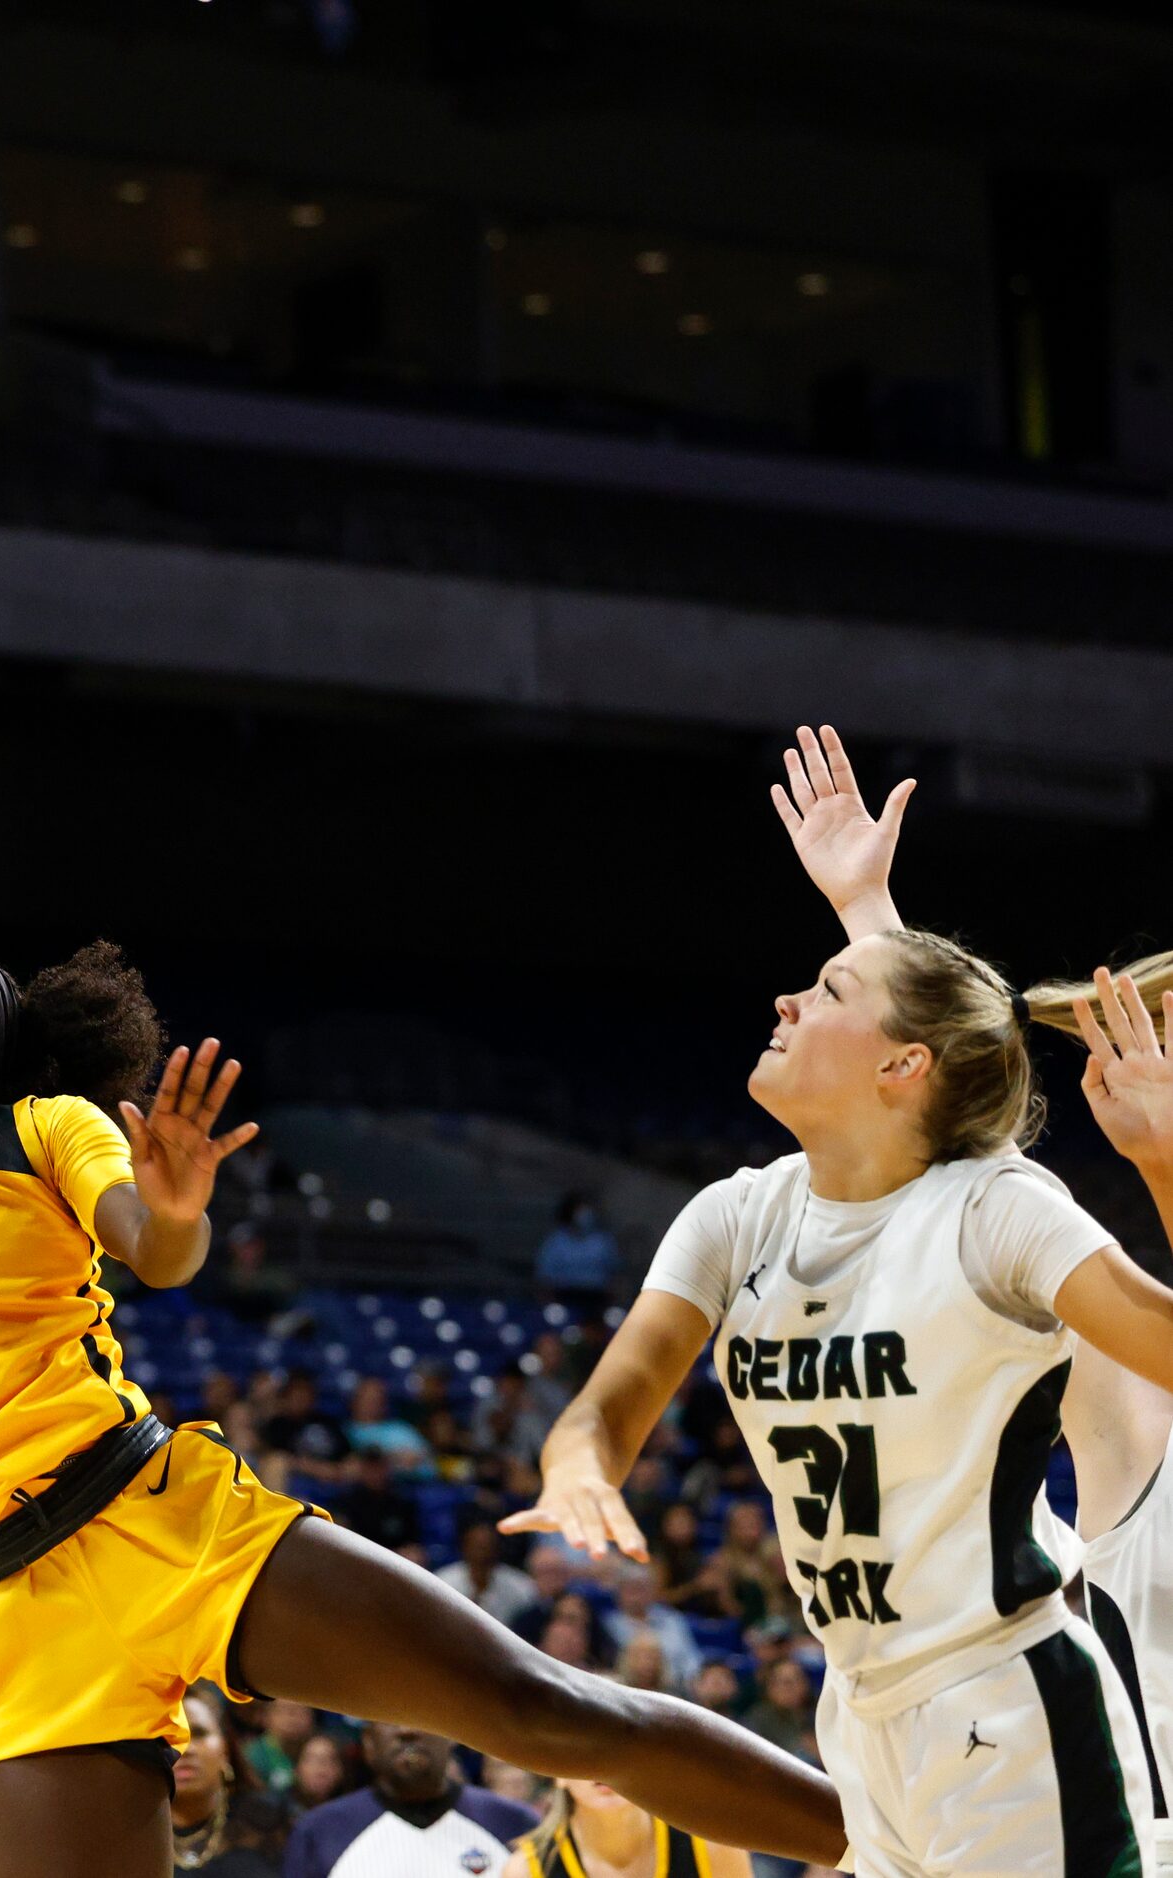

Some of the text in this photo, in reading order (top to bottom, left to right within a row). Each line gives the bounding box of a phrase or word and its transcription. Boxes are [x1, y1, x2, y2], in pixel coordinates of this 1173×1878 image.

[727, 1331, 917, 1401] CEDAR
[767, 1424, 880, 1540] 31
[795, 1558, 902, 1628] RK
